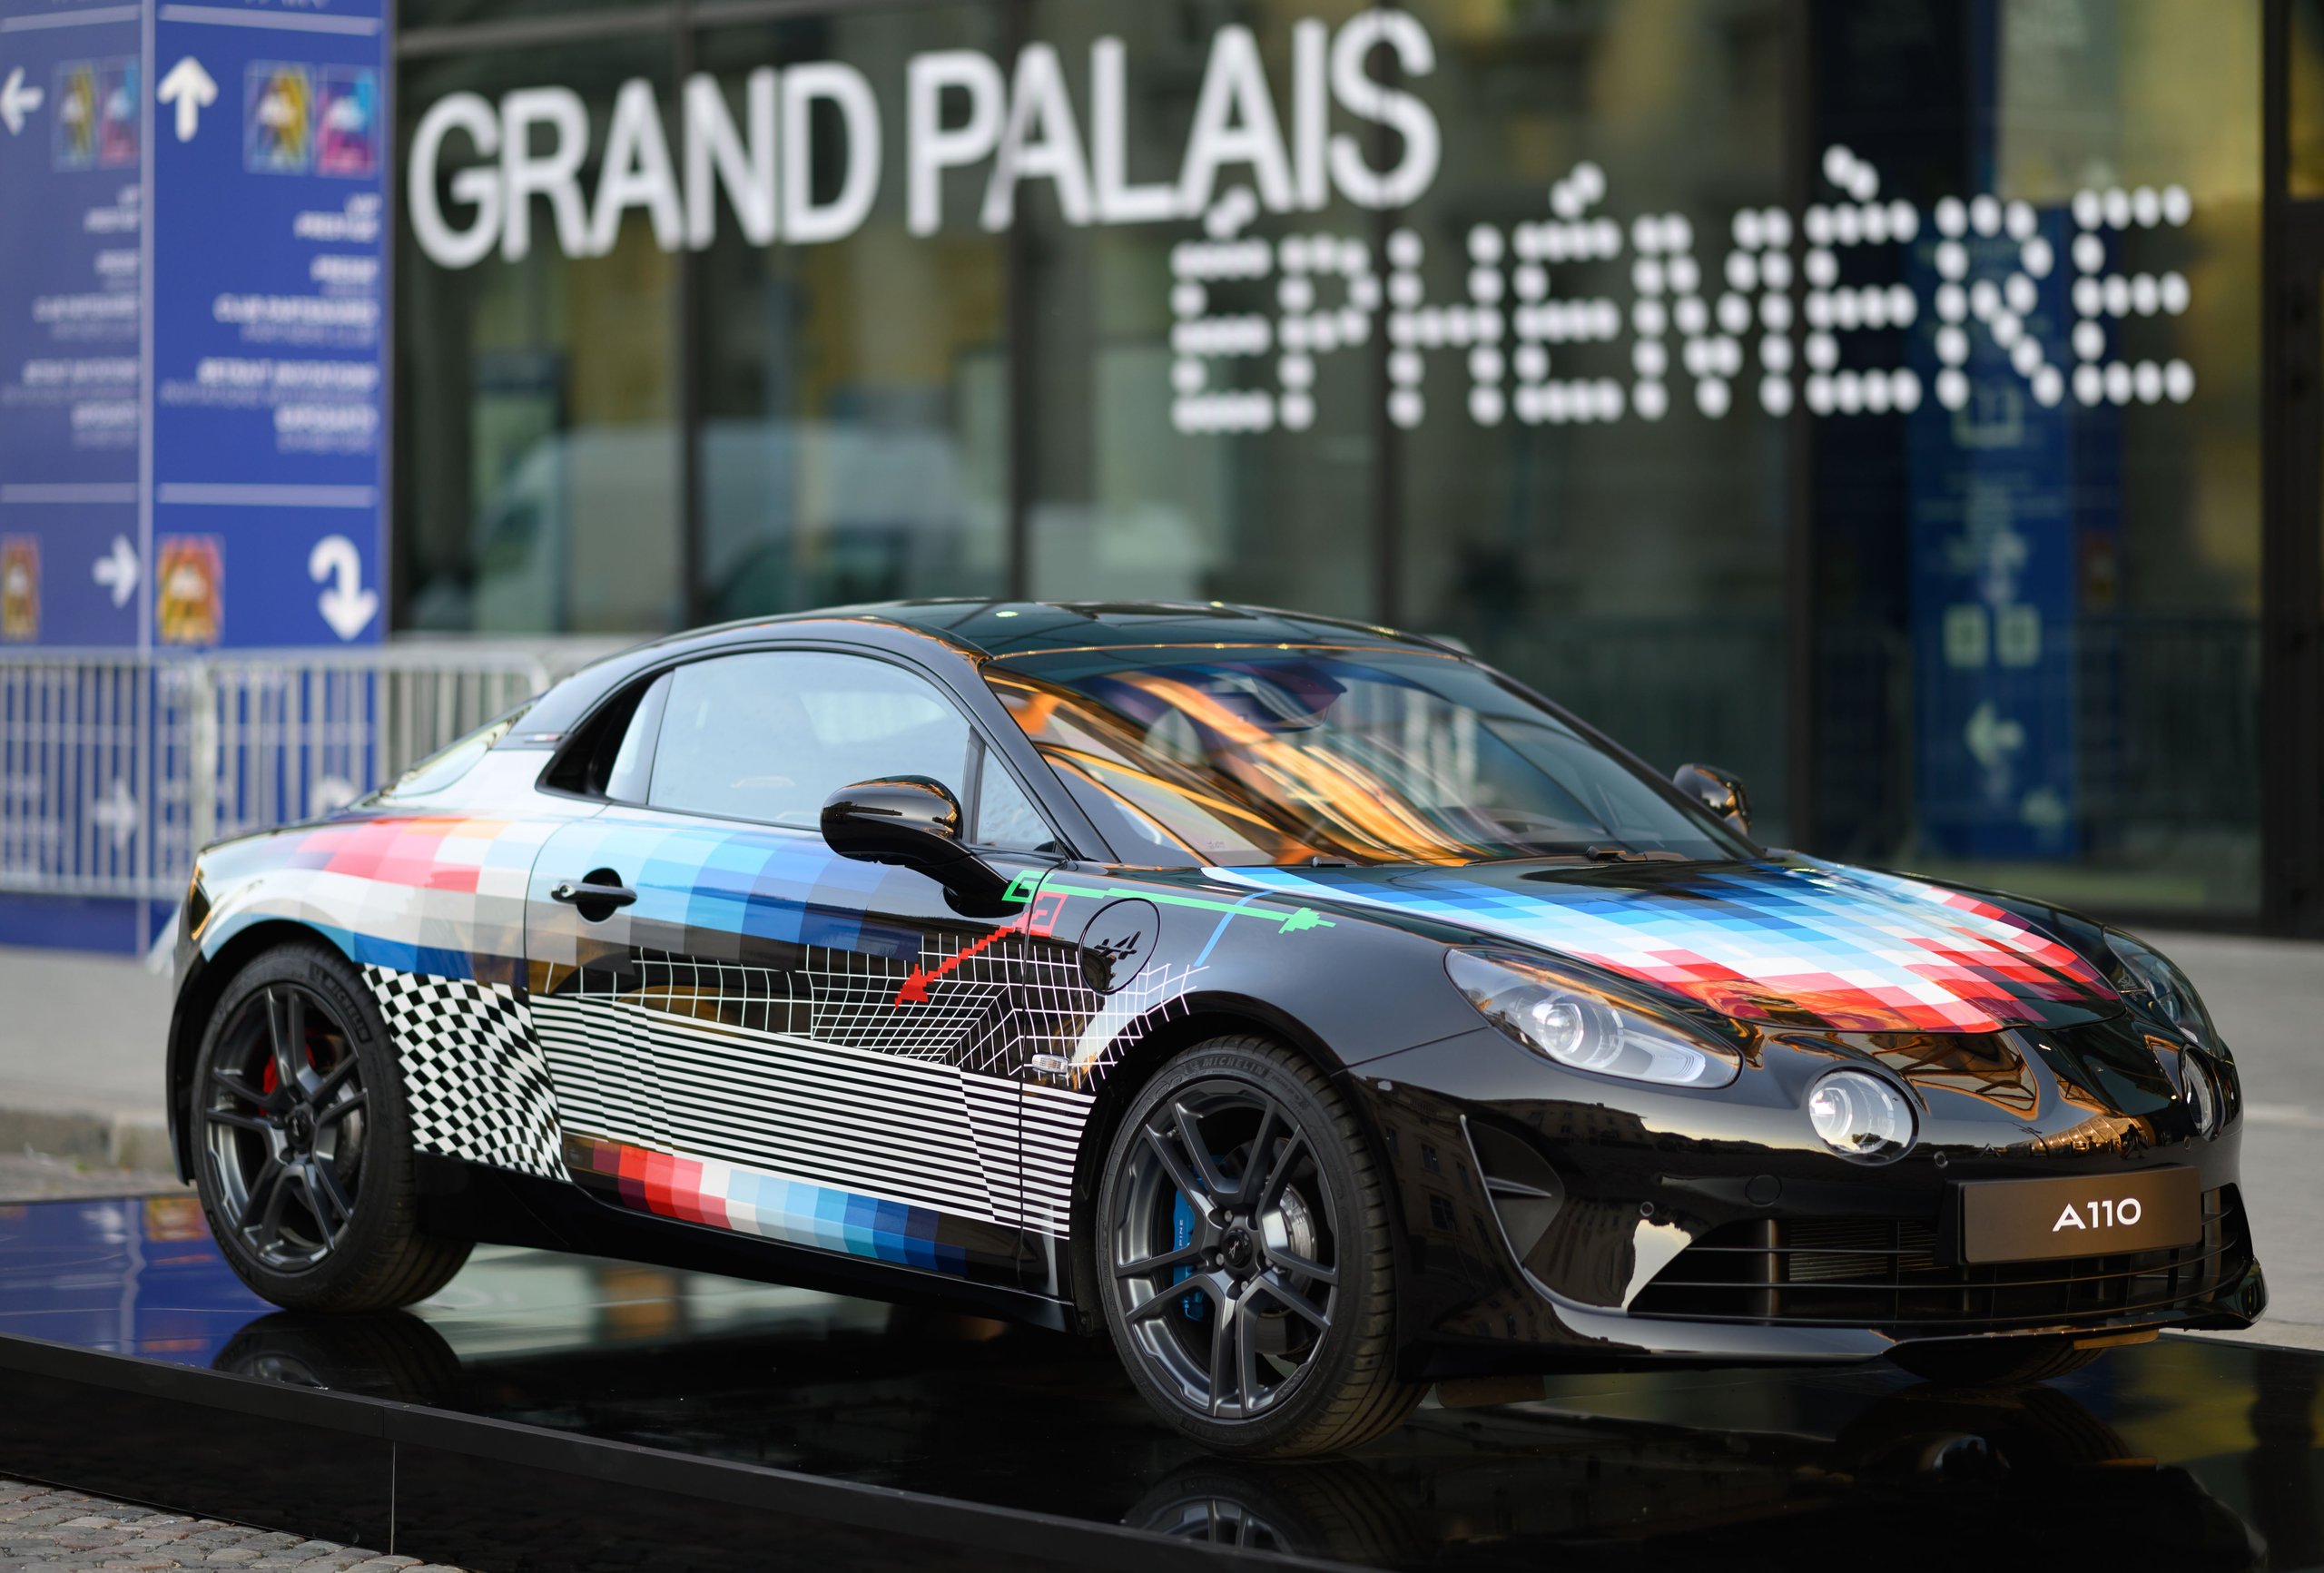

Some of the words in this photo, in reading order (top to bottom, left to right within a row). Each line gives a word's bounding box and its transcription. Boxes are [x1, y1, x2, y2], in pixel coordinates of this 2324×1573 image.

[408, 63, 881, 268] GRAND
[908, 10, 1441, 236] PALAIS
[1171, 145, 2193, 432] ÉPHÉMÈRE
[324, 977, 370, 1041] MICHELIN
[1202, 1056, 1265, 1078] MICHELIN
[2052, 1197, 2142, 1232] A110
